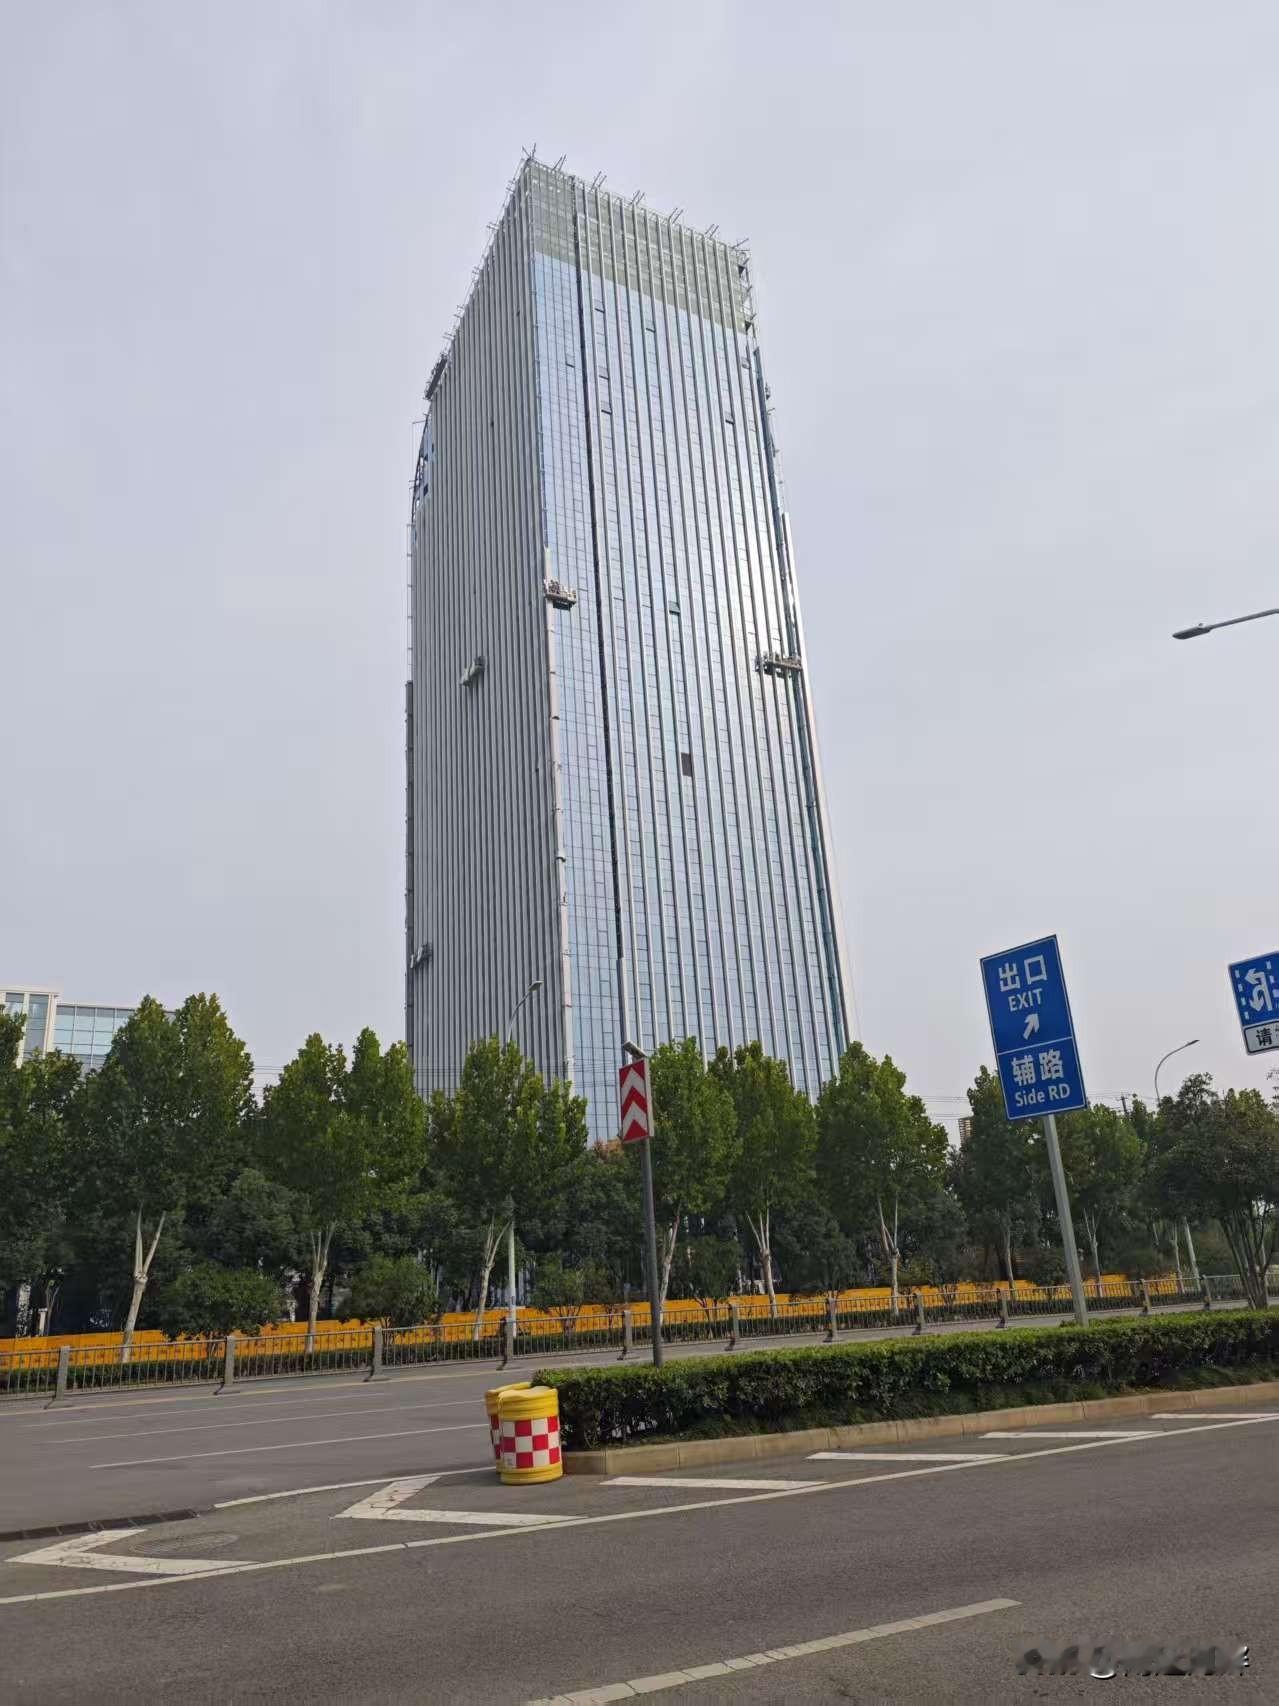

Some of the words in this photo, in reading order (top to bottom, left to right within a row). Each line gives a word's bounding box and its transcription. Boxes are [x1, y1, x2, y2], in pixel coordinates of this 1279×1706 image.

[999, 955, 1047, 992] 出口
[1008, 988, 1042, 1012] EXIT
[1011, 1049, 1064, 1086] 辅路
[1015, 1088, 1045, 1107] Side
[1048, 1083, 1071, 1101] RD
